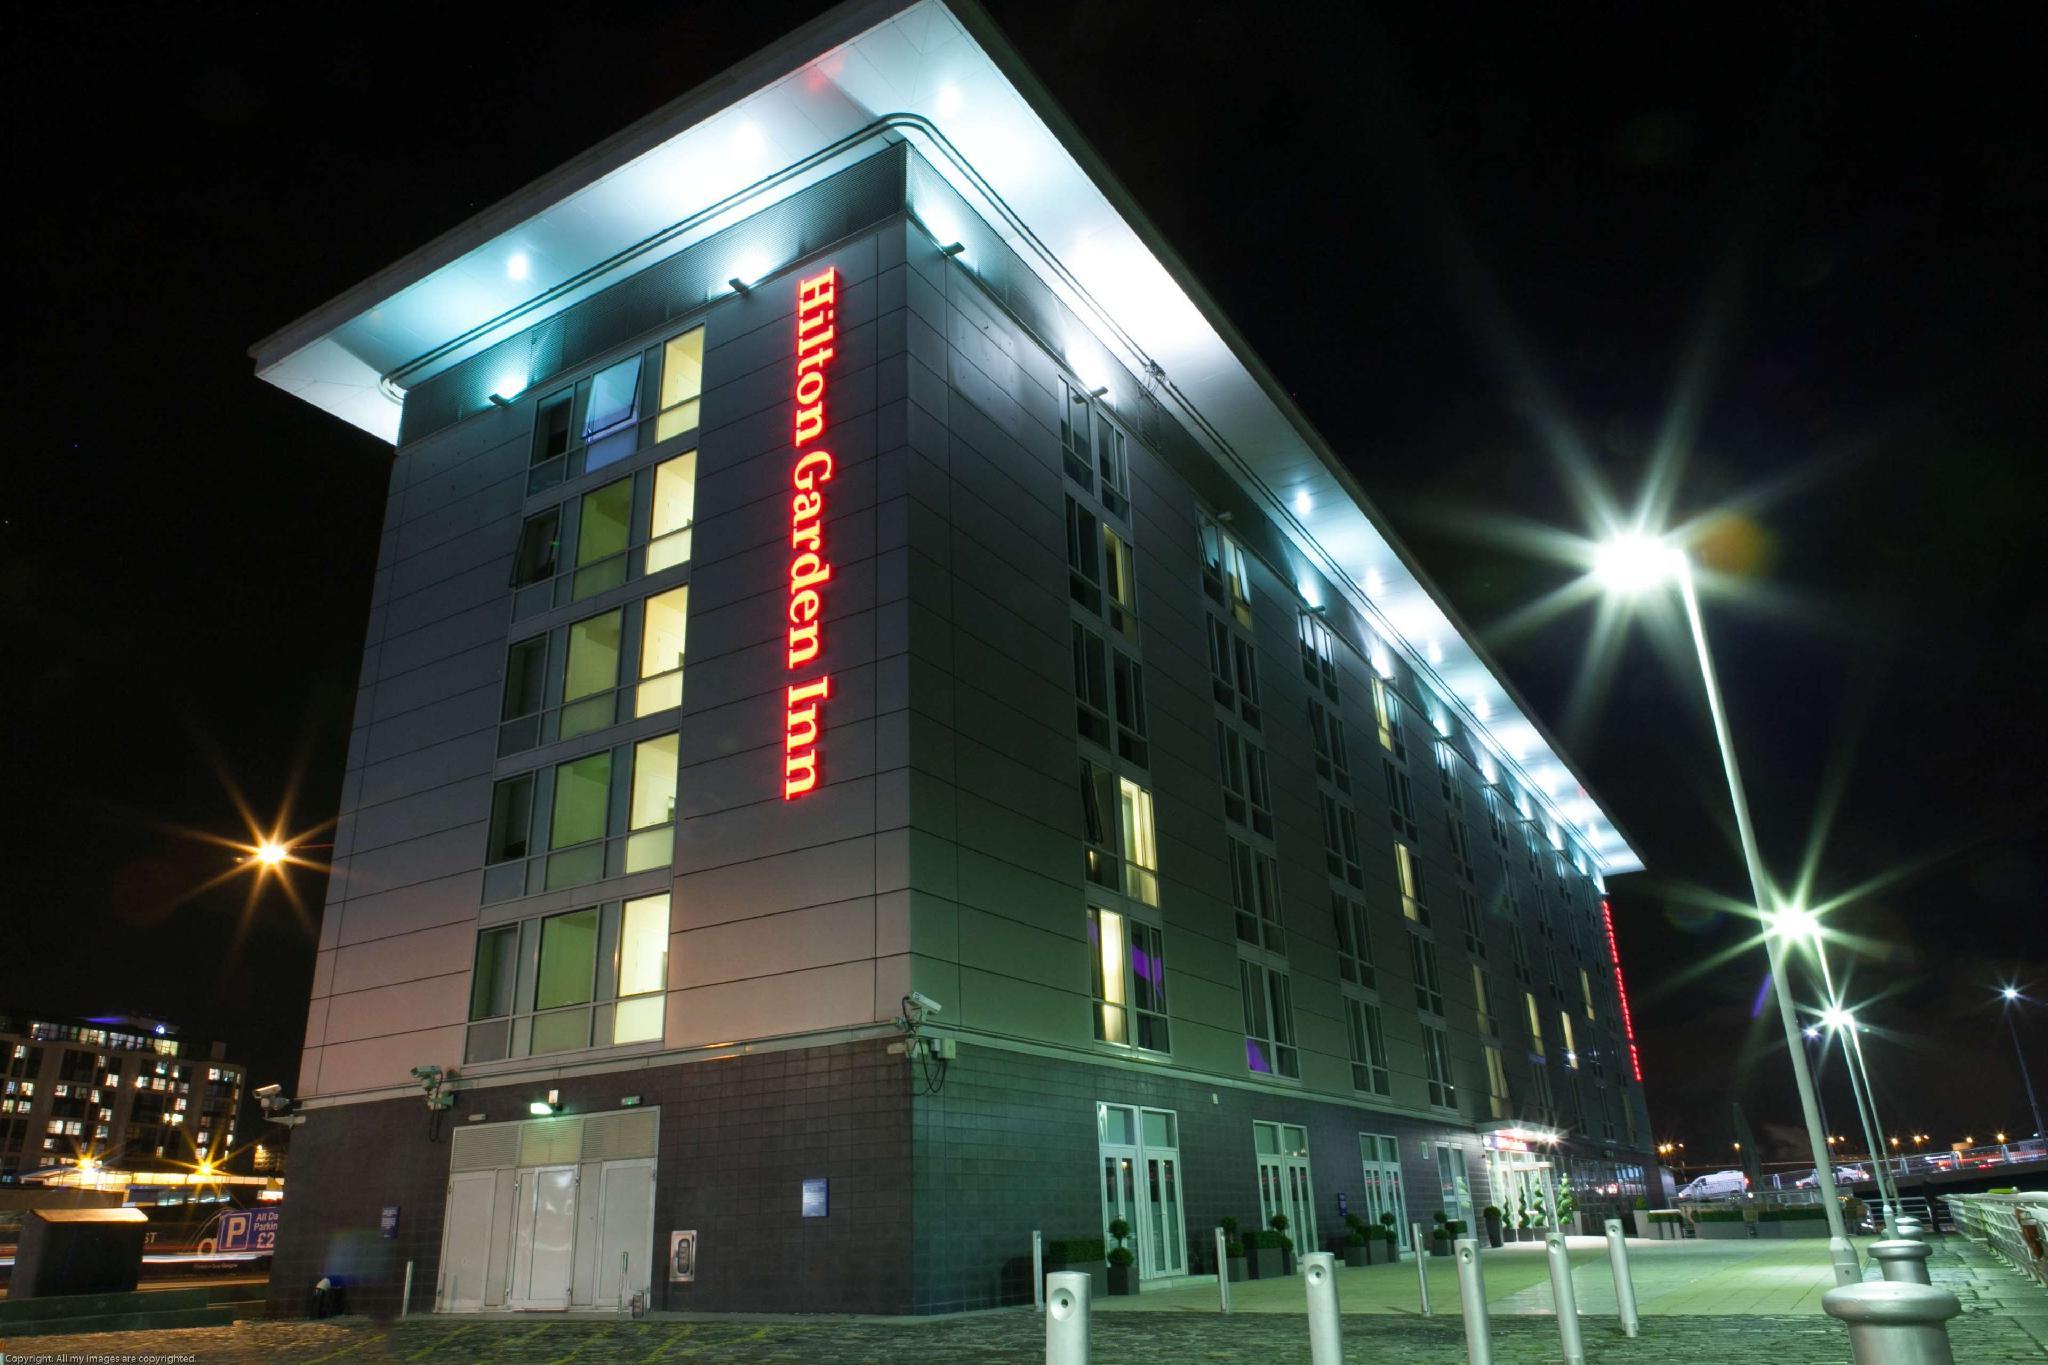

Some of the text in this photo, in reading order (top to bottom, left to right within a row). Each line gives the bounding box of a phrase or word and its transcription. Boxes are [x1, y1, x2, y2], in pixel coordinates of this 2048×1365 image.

[785, 266, 836, 800] Hilton Garden Inn
[226, 1216, 246, 1248] P
